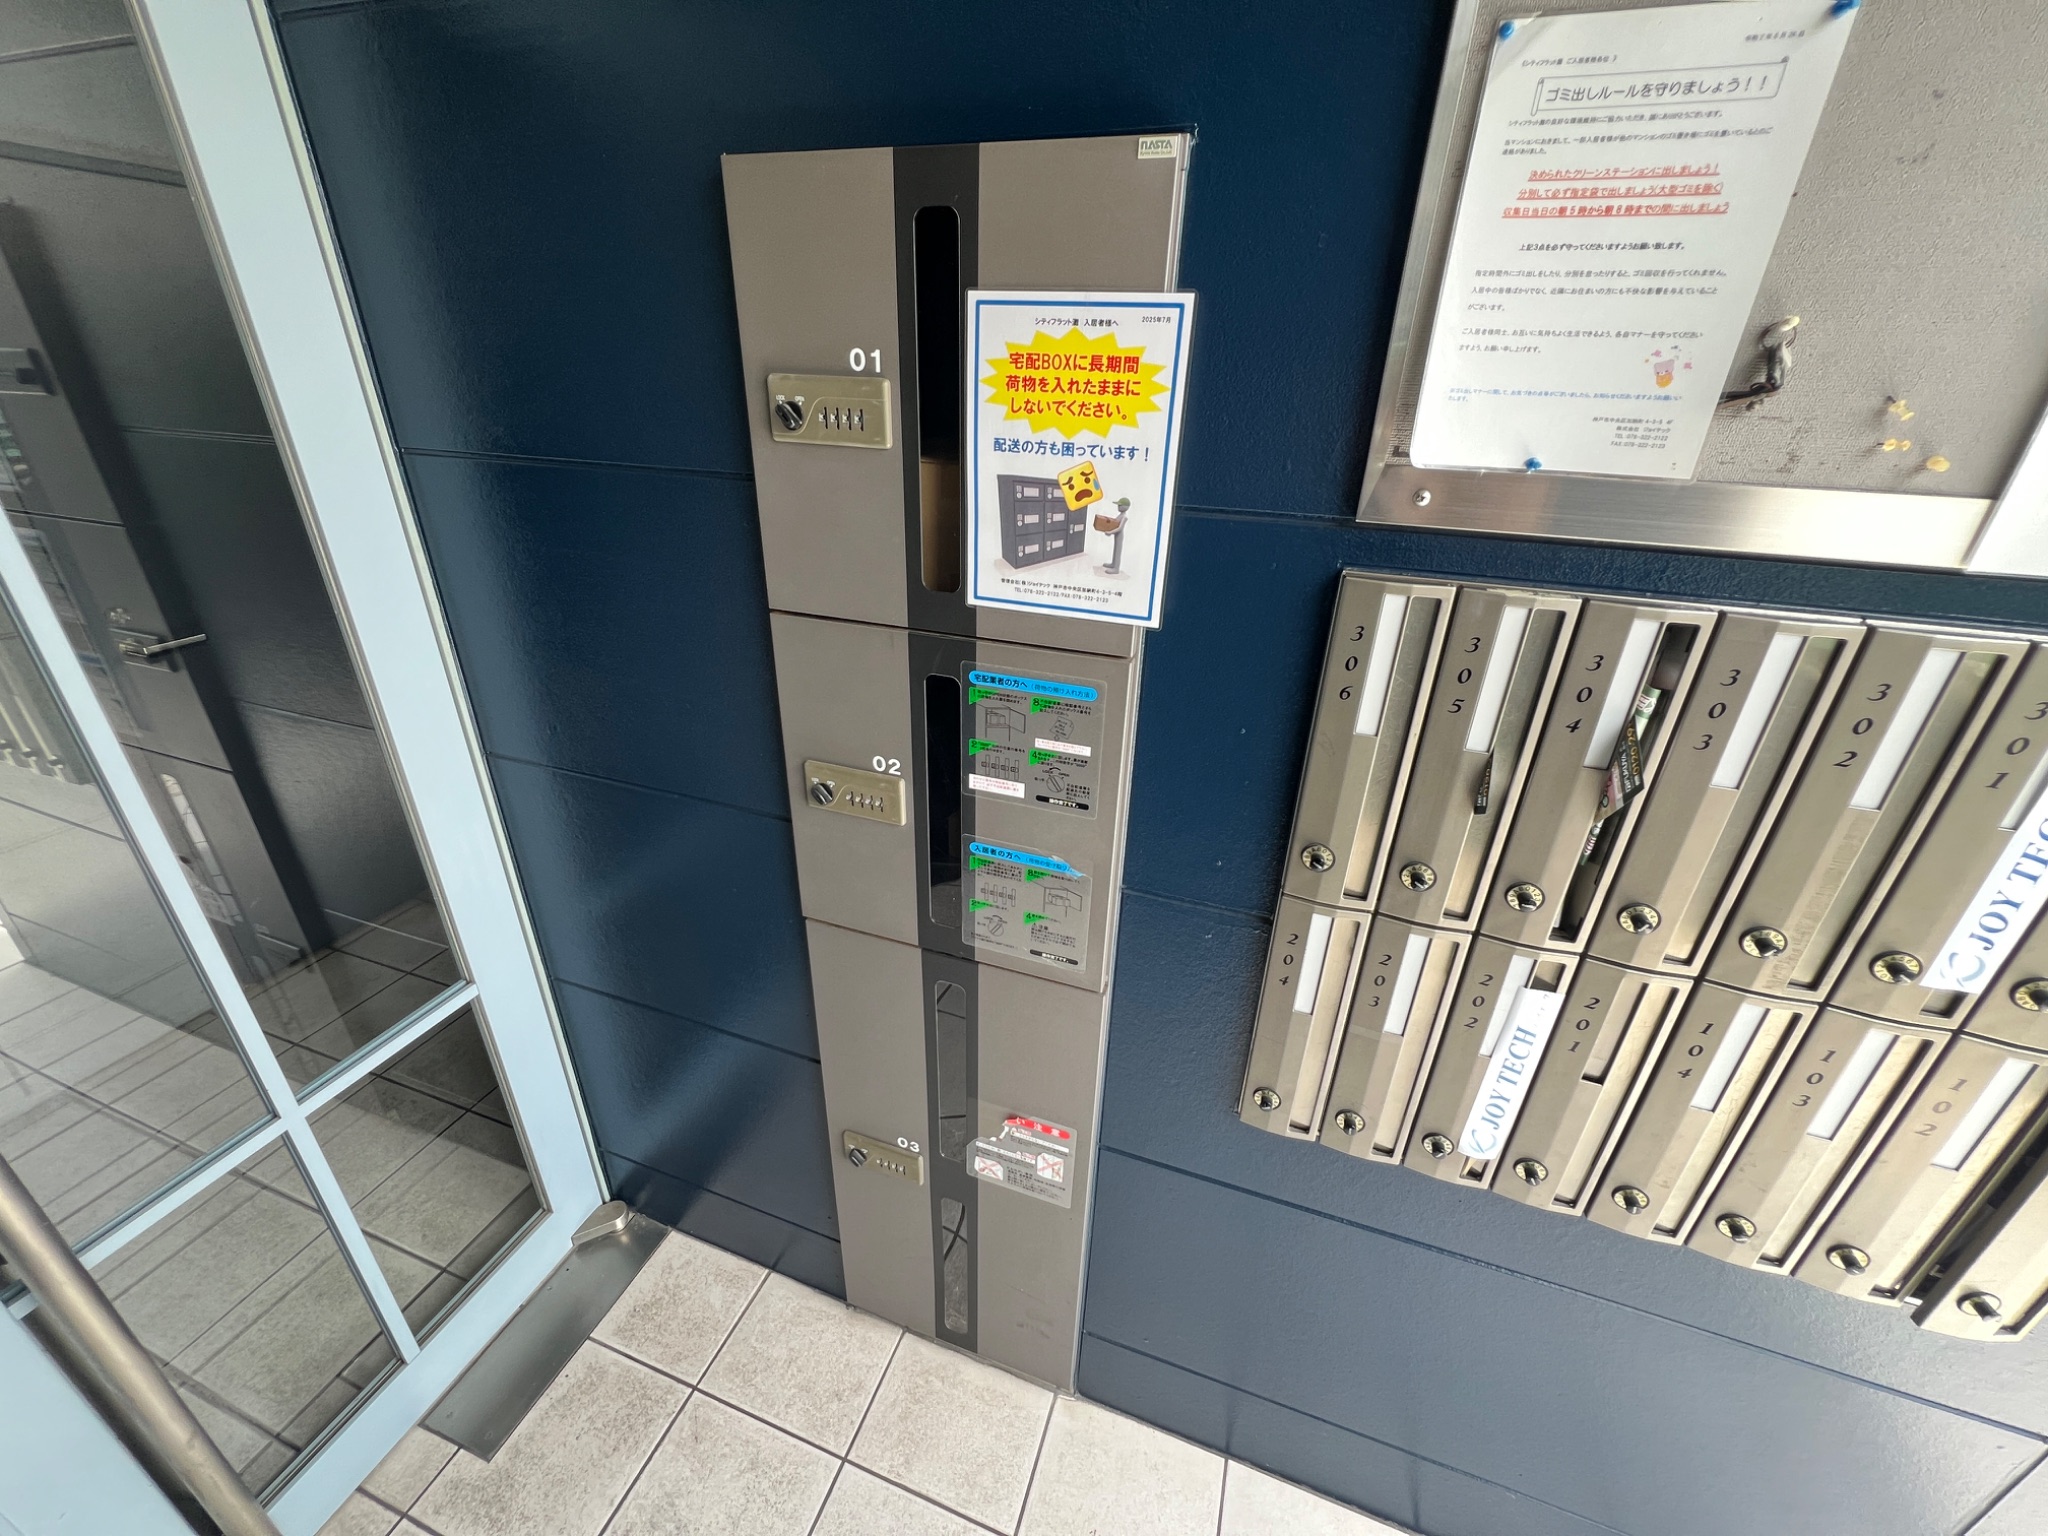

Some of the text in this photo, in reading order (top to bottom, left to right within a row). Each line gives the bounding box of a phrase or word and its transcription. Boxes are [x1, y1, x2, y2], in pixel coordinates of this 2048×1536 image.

[1545, 75, 1768, 101] ゴミ出しルールを守りましょう！！
[1142, 316, 1171, 324] 2025年7月
[850, 347, 881, 373] 01
[1005, 375, 1141, 396] 荷物を入れたままに
[1009, 351, 1140, 374] 宅配BOXに長期間
[1010, 397, 1127, 420] しないでください。
[993, 437, 1149, 462] 配送の方も困っています！
[1339, 626, 1364, 701] 306
[1448, 637, 1481, 713] 305
[1565, 655, 1604, 733] 304
[1693, 669, 1742, 750] 303
[1833, 684, 1892, 767] 302
[1985, 702, 2048, 789] 301
[872, 755, 901, 775] 02
[1968, 890, 2025, 951] JOY
[1279, 933, 1299, 986] 204
[1367, 954, 1392, 1008] 203
[1463, 974, 1494, 1029] 202
[1568, 997, 1601, 1053] 201
[1481, 1025, 1537, 1130] JOY TECH
[1677, 1022, 1715, 1079] 104
[1792, 1049, 1837, 1107] 103
[1914, 1078, 1969, 1136] 102
[897, 1137, 920, 1152] 03
